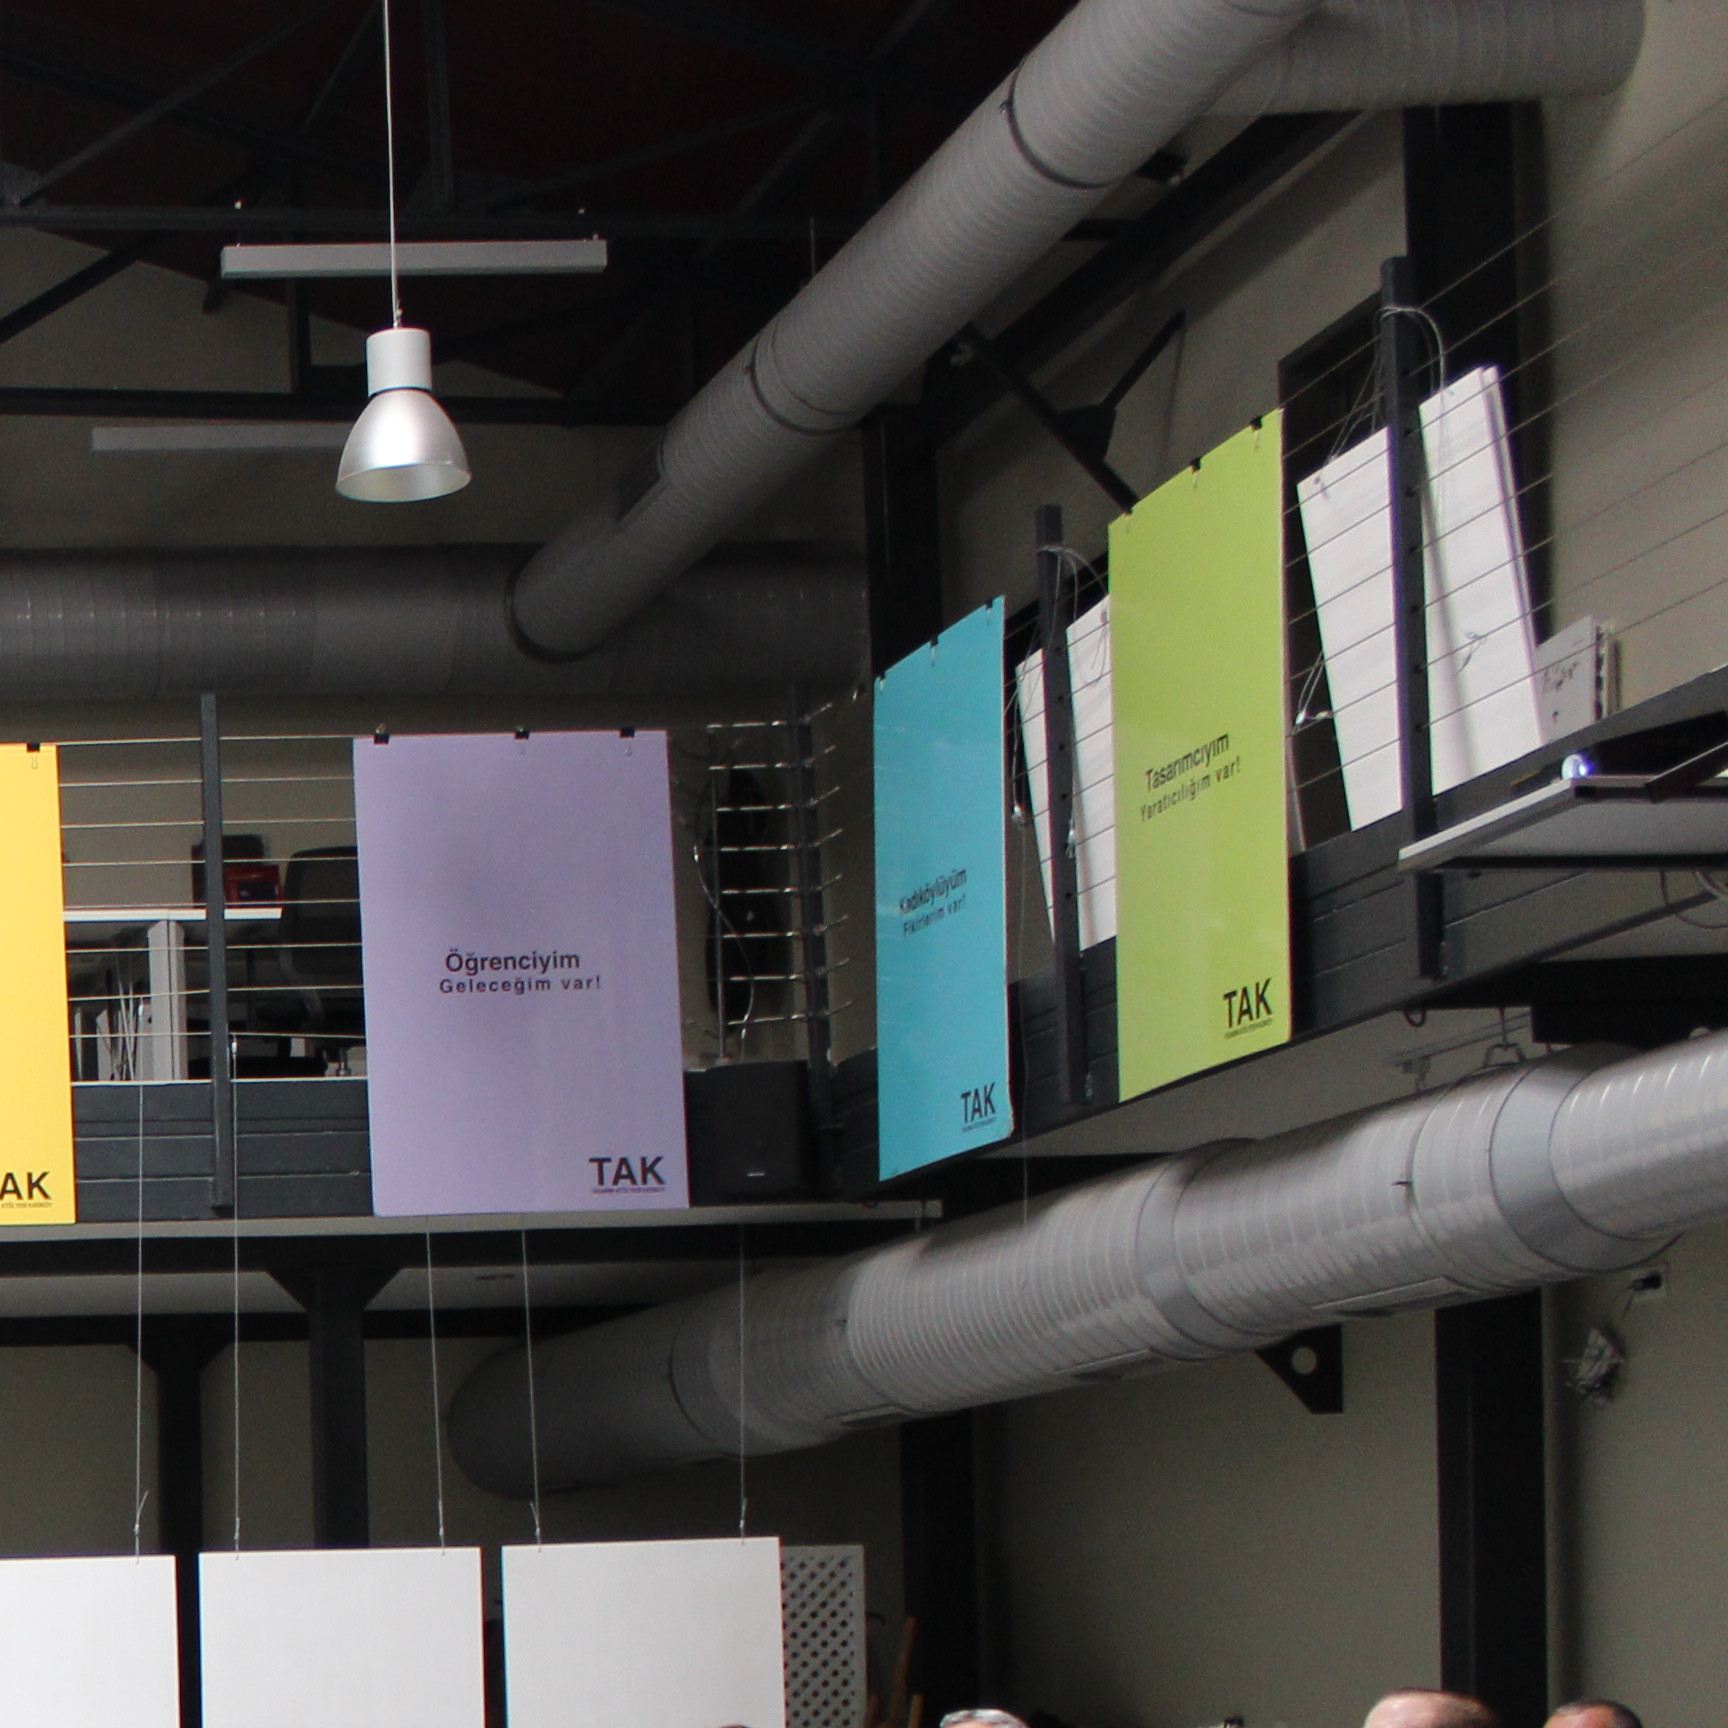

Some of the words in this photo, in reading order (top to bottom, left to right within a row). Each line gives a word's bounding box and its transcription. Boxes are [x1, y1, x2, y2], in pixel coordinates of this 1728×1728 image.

[1145, 733, 1229, 793] Tasarımcıyım
[1215, 756, 1241, 782] var!
[445, 949, 581, 976] Öğrenciyim
[439, 976, 552, 996] Geleceğim
[560, 974, 602, 991] var!
[1222, 977, 1274, 1030] TAK
[960, 1082, 997, 1124] TAK
[588, 1155, 666, 1187] TAK
